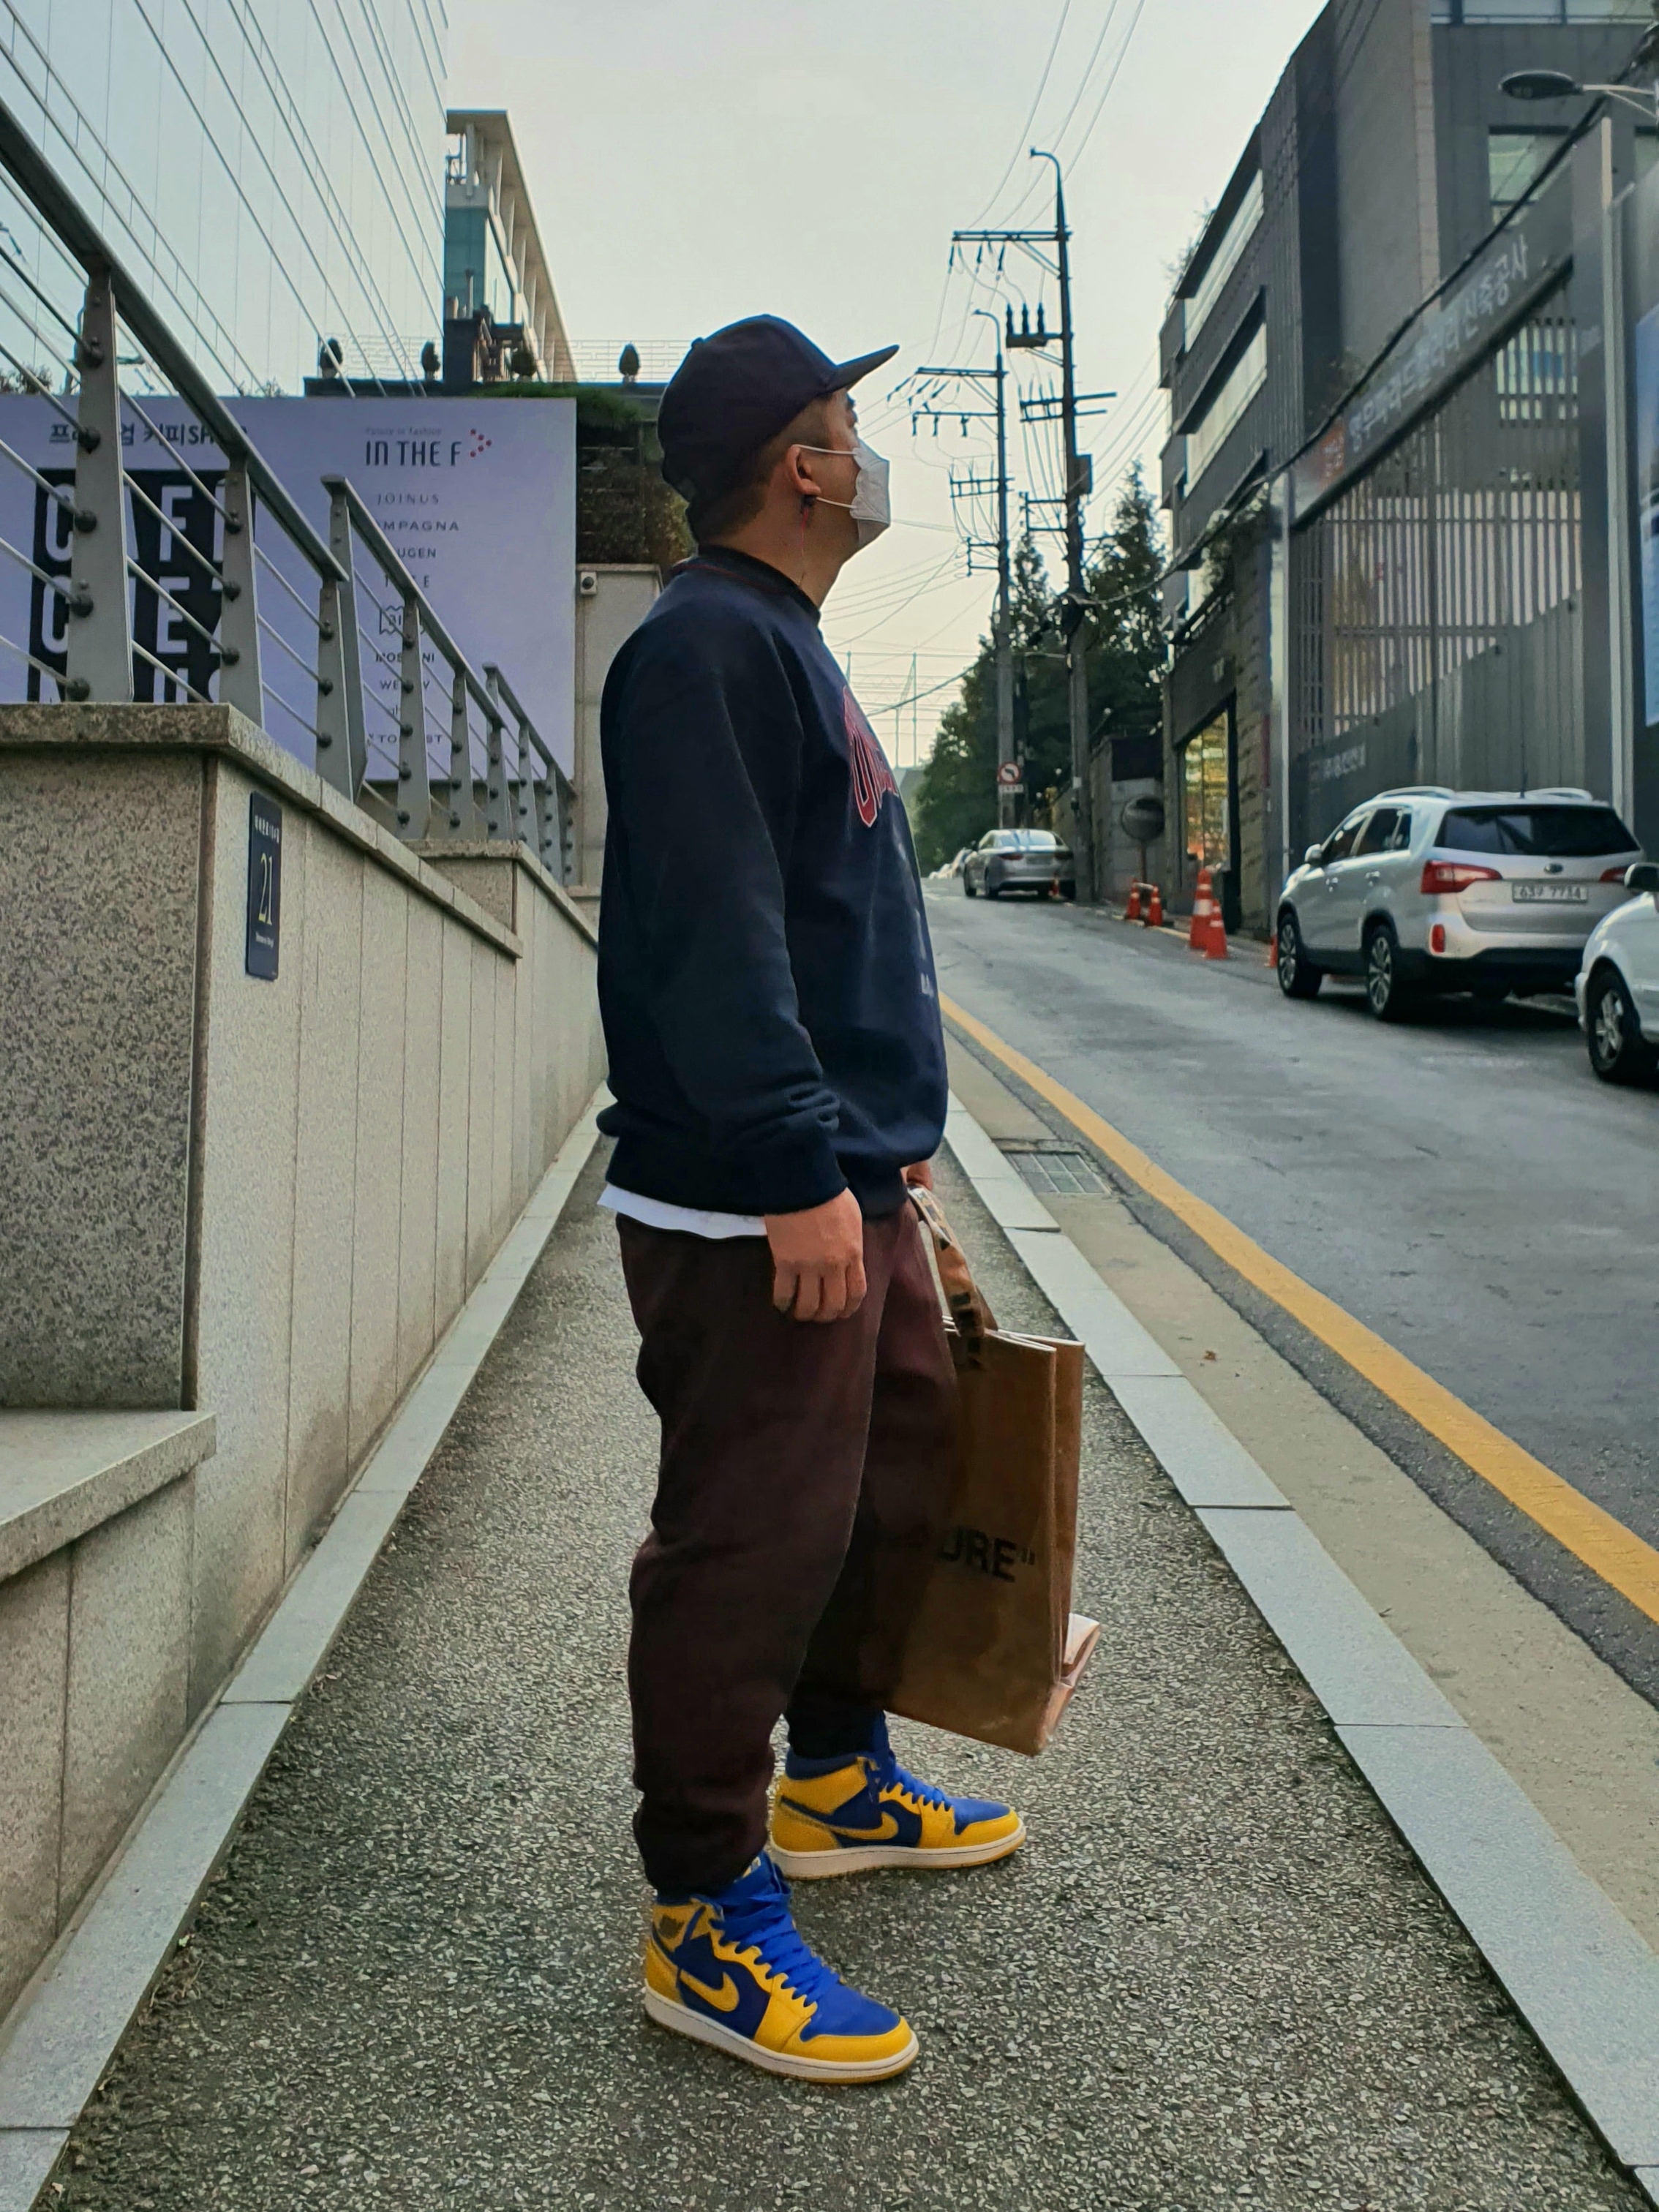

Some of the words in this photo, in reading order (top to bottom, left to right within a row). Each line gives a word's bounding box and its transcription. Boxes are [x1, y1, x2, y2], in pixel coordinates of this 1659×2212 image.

[397, 440, 441, 467] THE
[450, 440, 462, 467] F
[377, 492, 439, 505] JOINUS
[379, 520, 459, 531] MPAGNA
[398, 546, 437, 558] UGEN
[258, 851, 273, 925] 21
